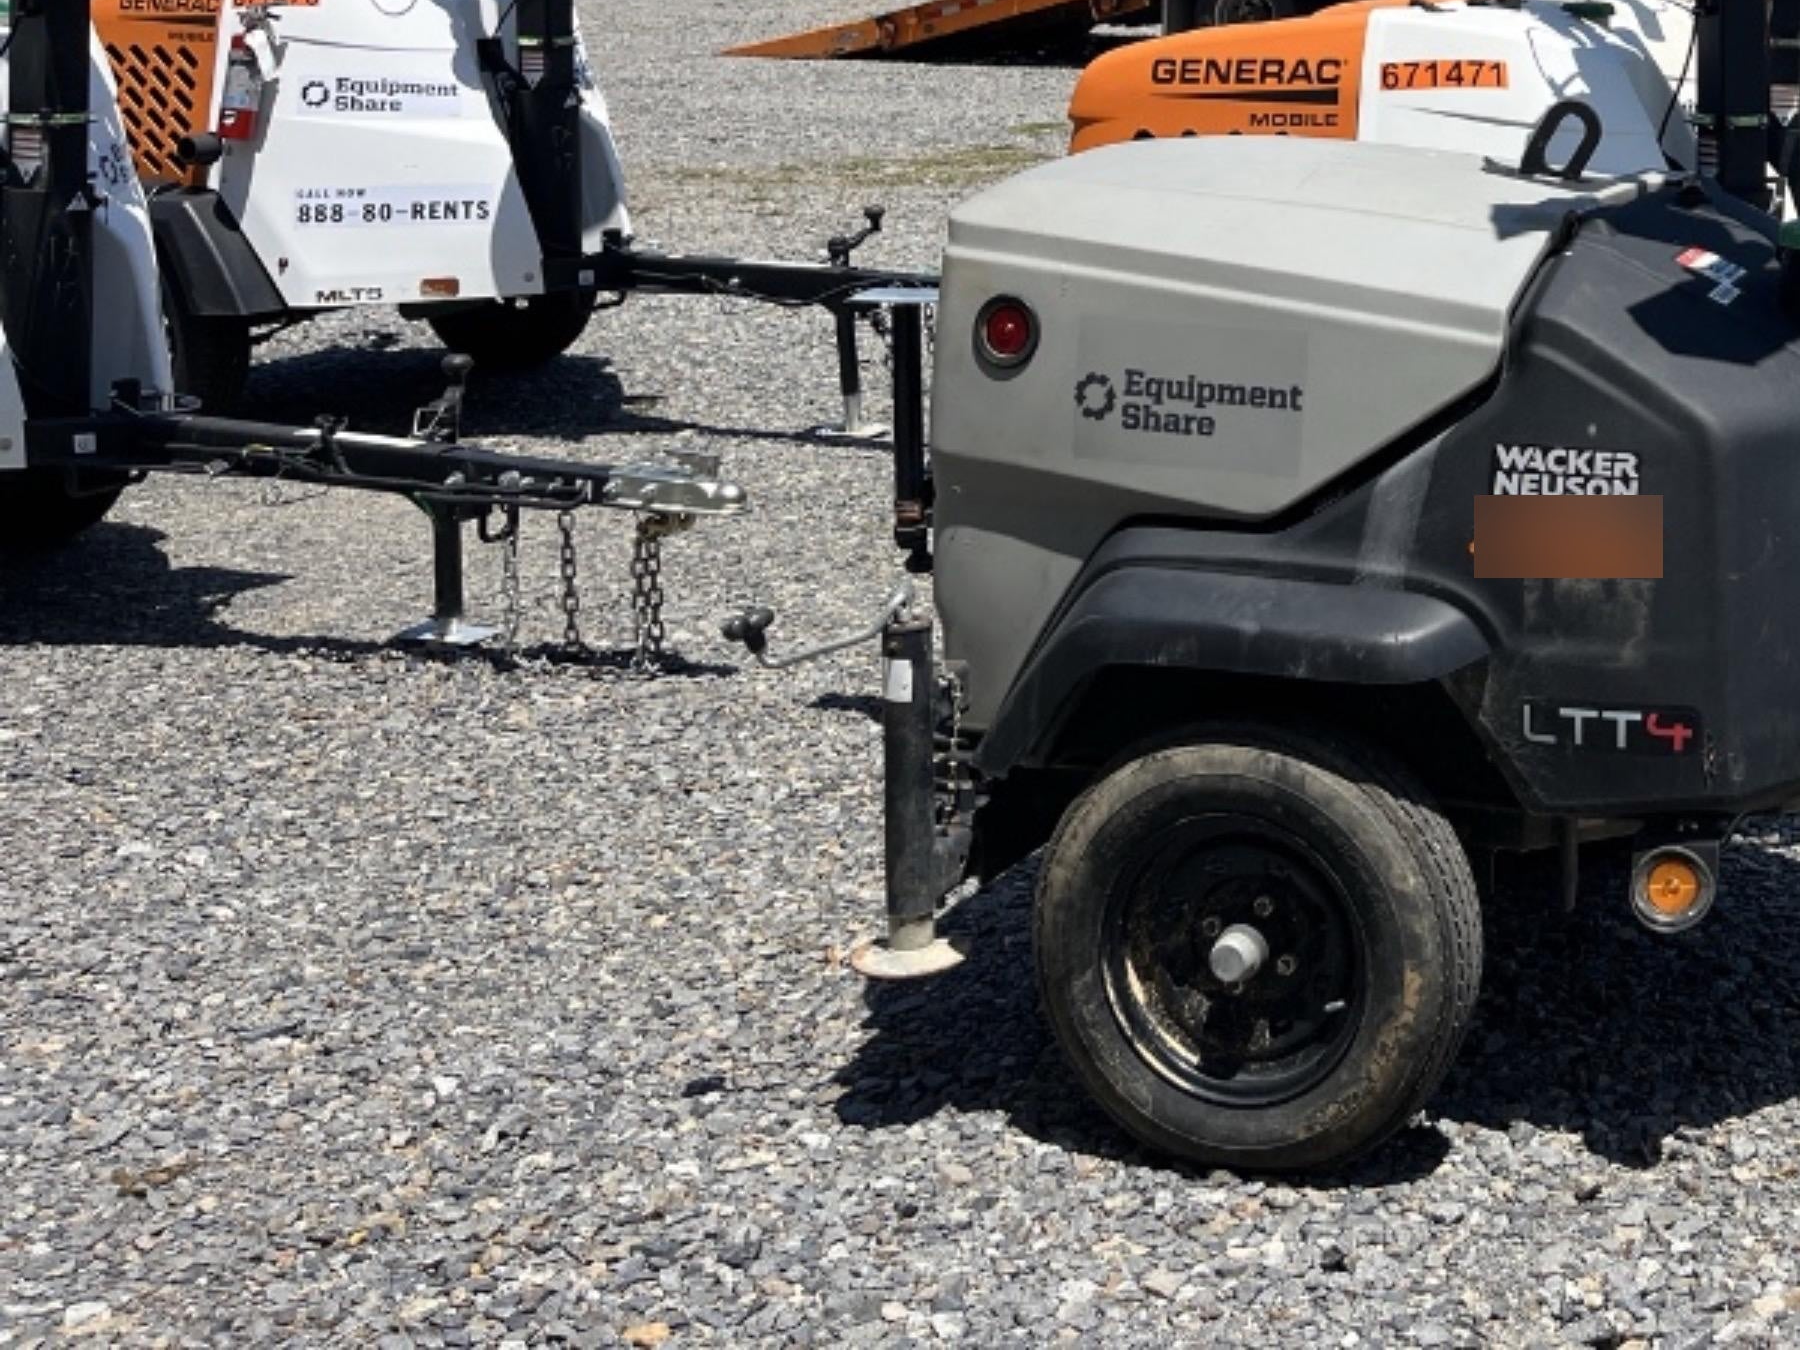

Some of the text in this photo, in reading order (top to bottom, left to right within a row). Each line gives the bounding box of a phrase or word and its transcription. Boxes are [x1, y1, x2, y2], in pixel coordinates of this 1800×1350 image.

[1151, 58, 1340, 85] GENERAC
[1382, 61, 1505, 89] 671471
[335, 77, 458, 97] Equipment
[335, 95, 402, 112] Share
[1250, 113, 1339, 127] MOBILE
[1123, 368, 1303, 412] Equipment
[1121, 402, 1216, 436] Share
[1496, 443, 1640, 478] WACKER
[1494, 470, 1639, 495] NEUSON
[1523, 704, 1692, 751] LTT4
